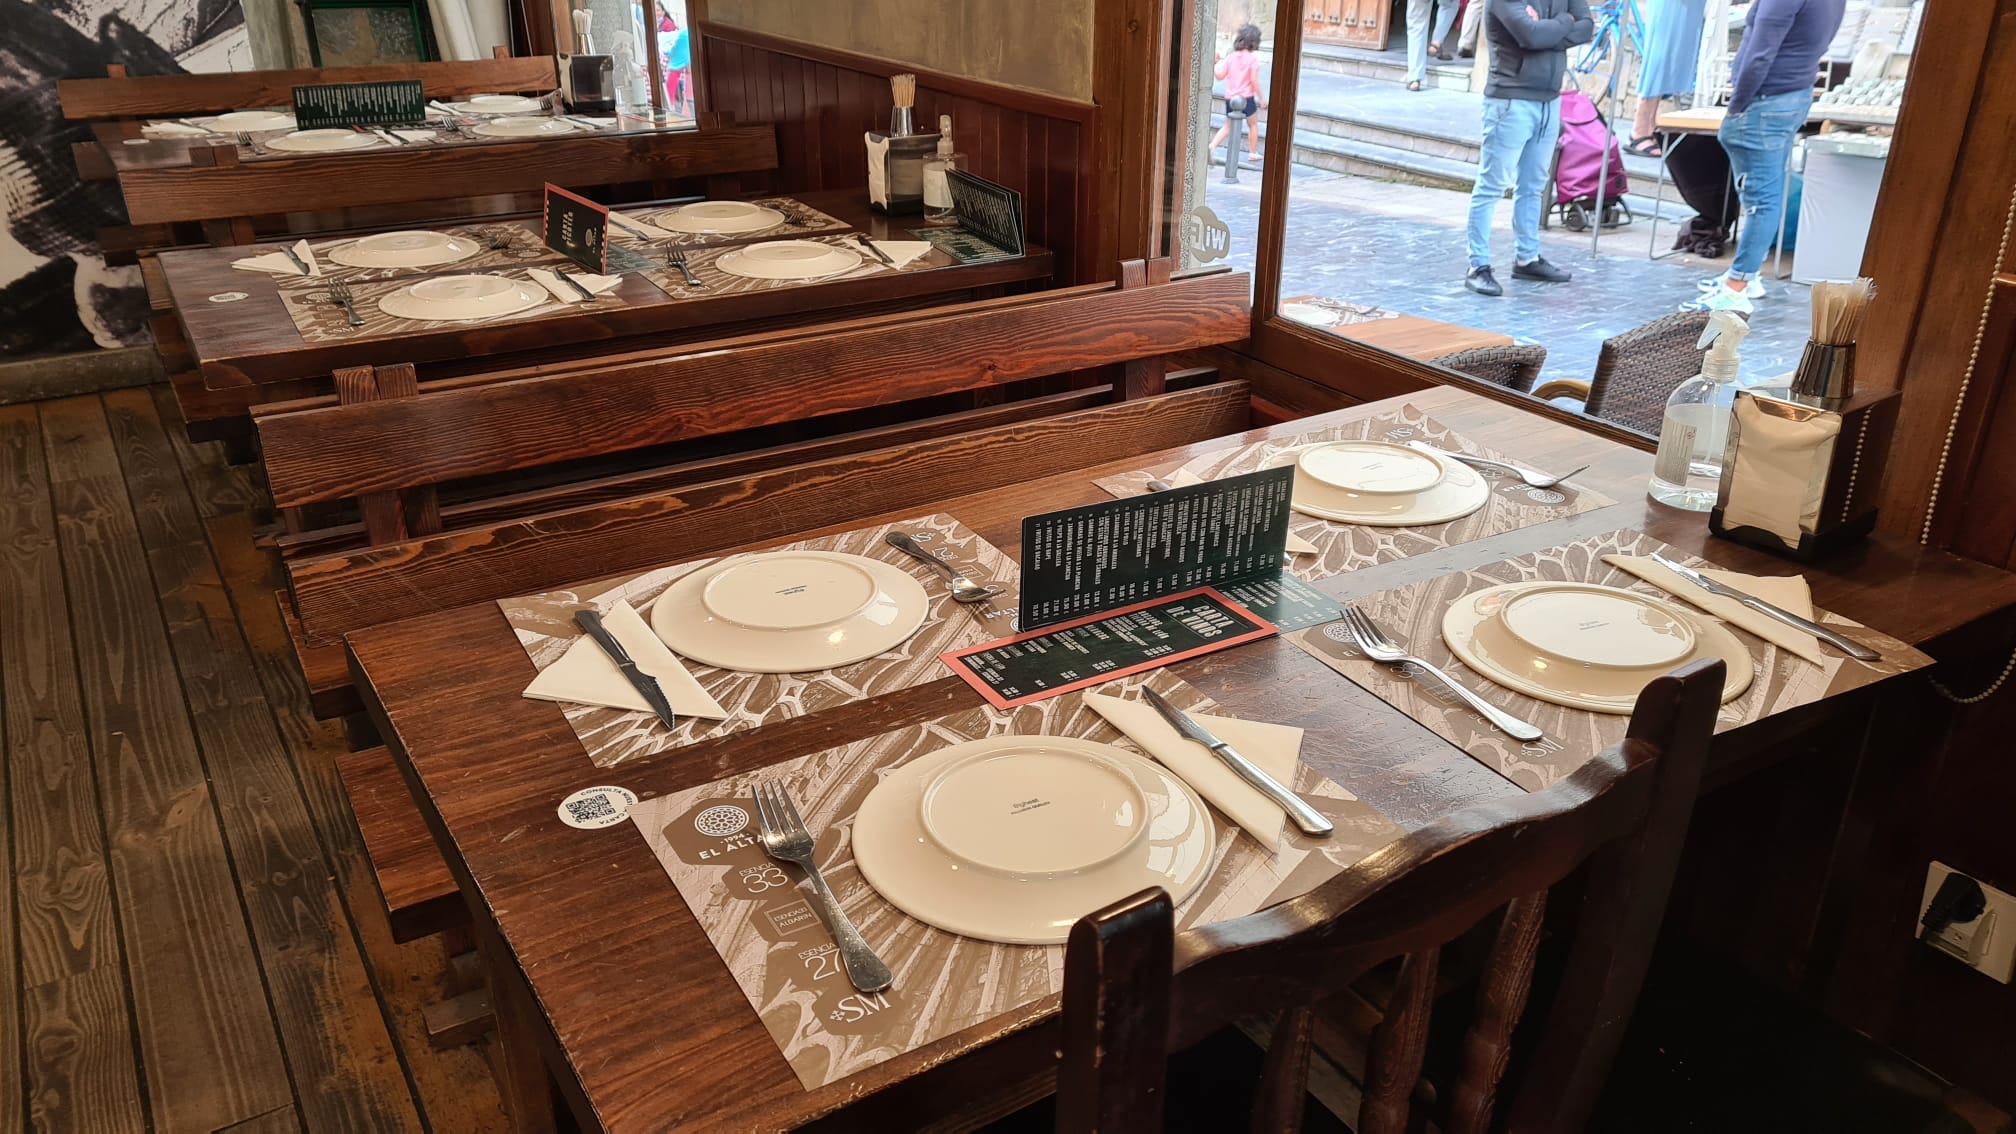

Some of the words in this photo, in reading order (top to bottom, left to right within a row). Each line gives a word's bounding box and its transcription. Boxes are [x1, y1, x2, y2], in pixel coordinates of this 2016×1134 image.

[1166, 605, 1185, 618] DE
[1180, 615, 1222, 639] VINOS
[1192, 605, 1235, 628] CARTA
[580, 787, 622, 796] CONSULTA
[599, 812, 625, 825] CARTA
[698, 848, 721, 860] EL
[743, 867, 788, 893] 33
[798, 942, 836, 960] ESENCIA
[804, 948, 841, 981] 27
[838, 992, 891, 1023] SM
